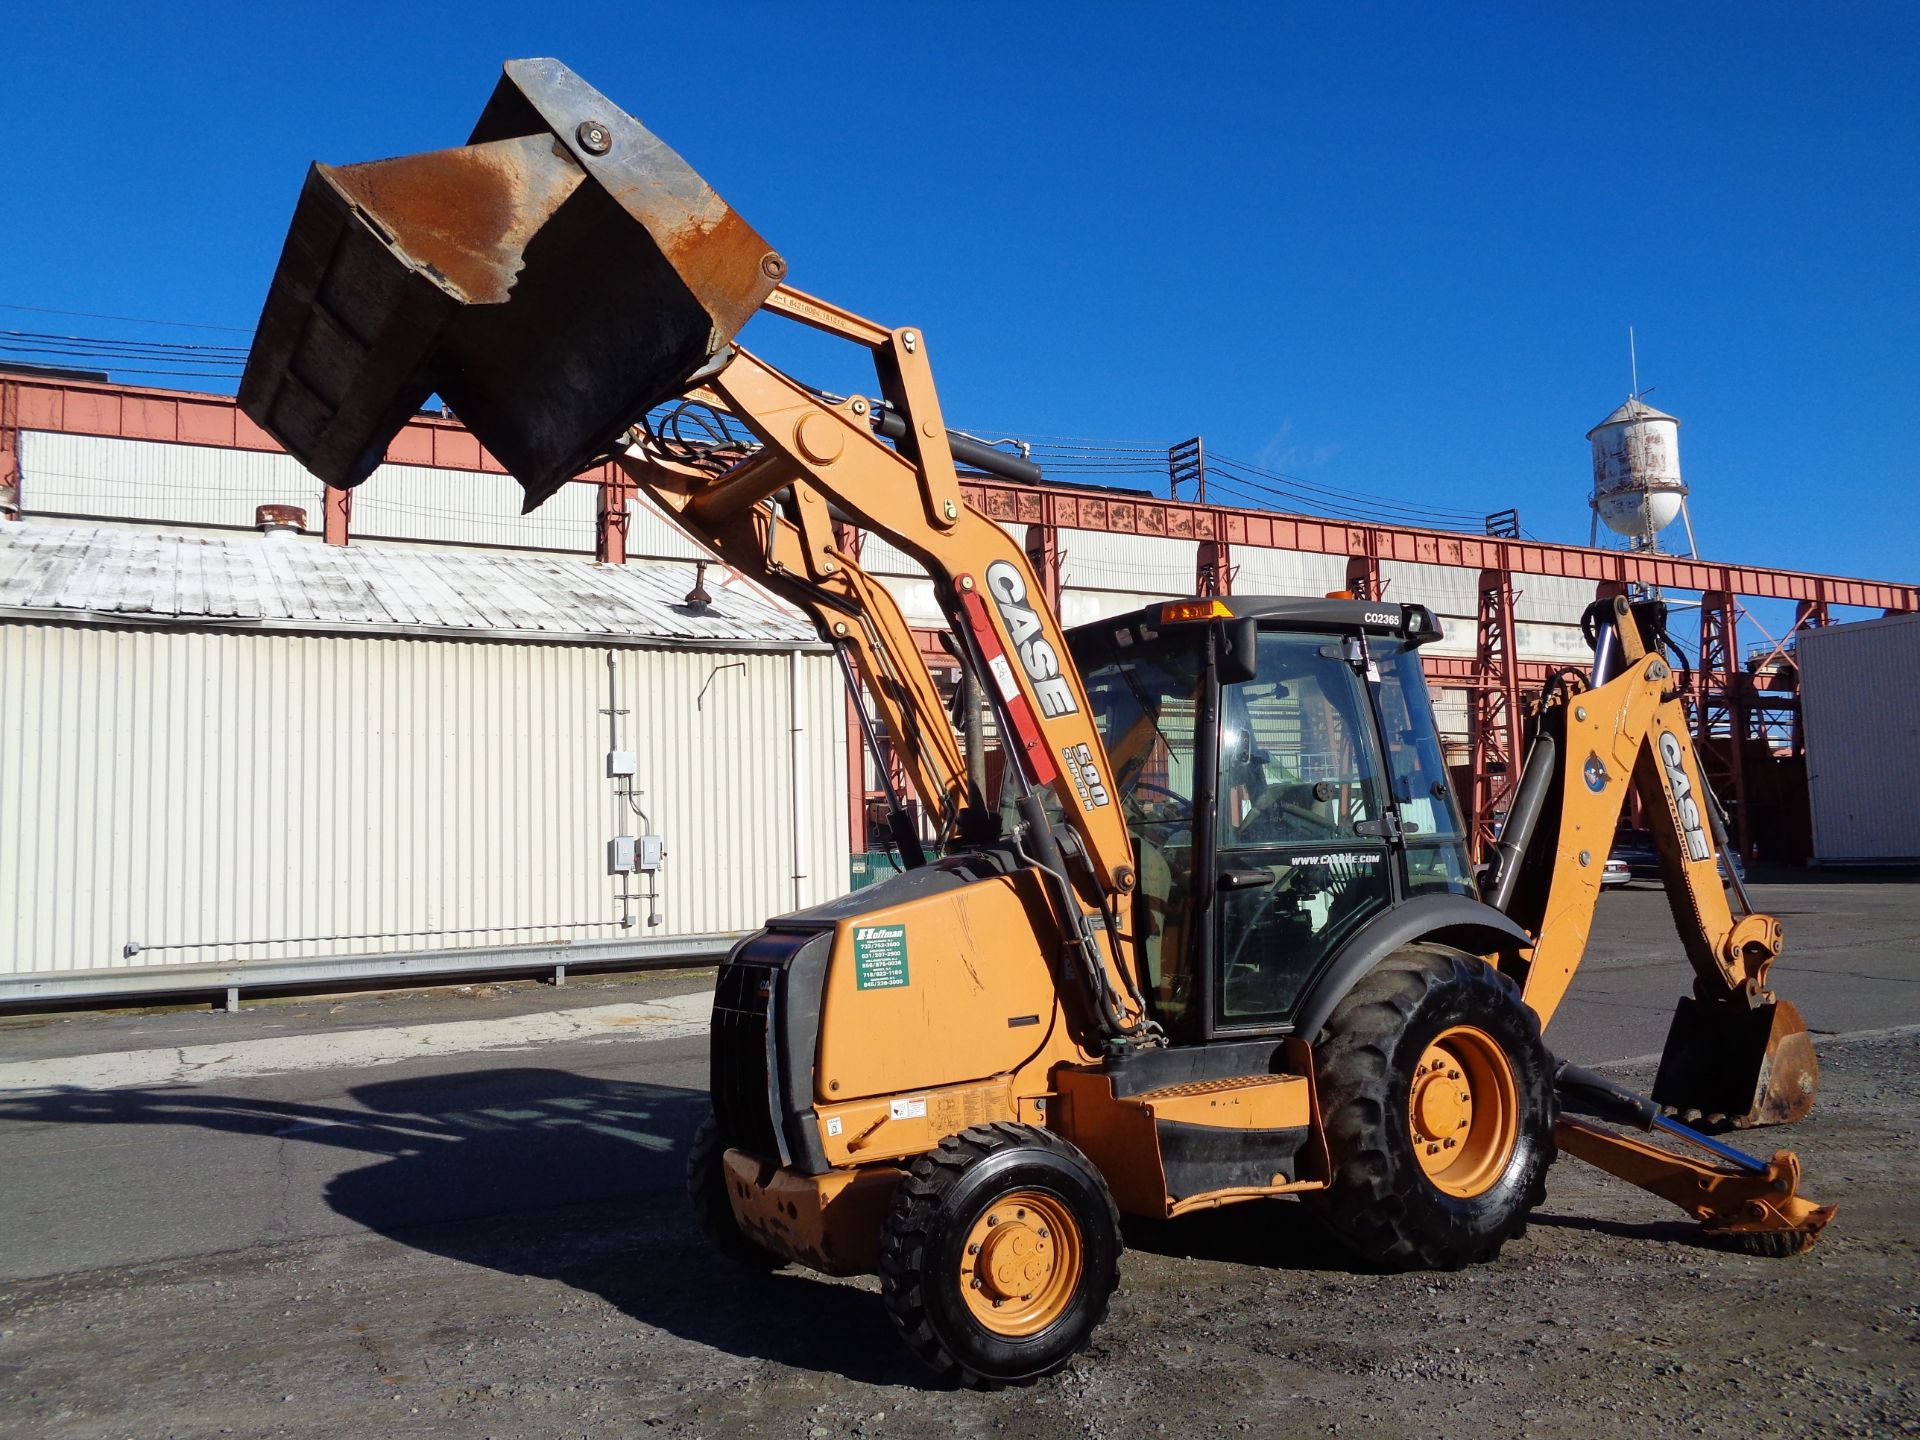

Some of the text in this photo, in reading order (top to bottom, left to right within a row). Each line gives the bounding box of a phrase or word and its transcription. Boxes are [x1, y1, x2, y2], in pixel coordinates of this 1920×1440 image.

[986, 560, 1079, 718] CASE
[1062, 747, 1094, 811] SUPER N
[1071, 742, 1109, 807] 580
[1659, 731, 1710, 861] CASE
[856, 927, 904, 941] Hoffman
